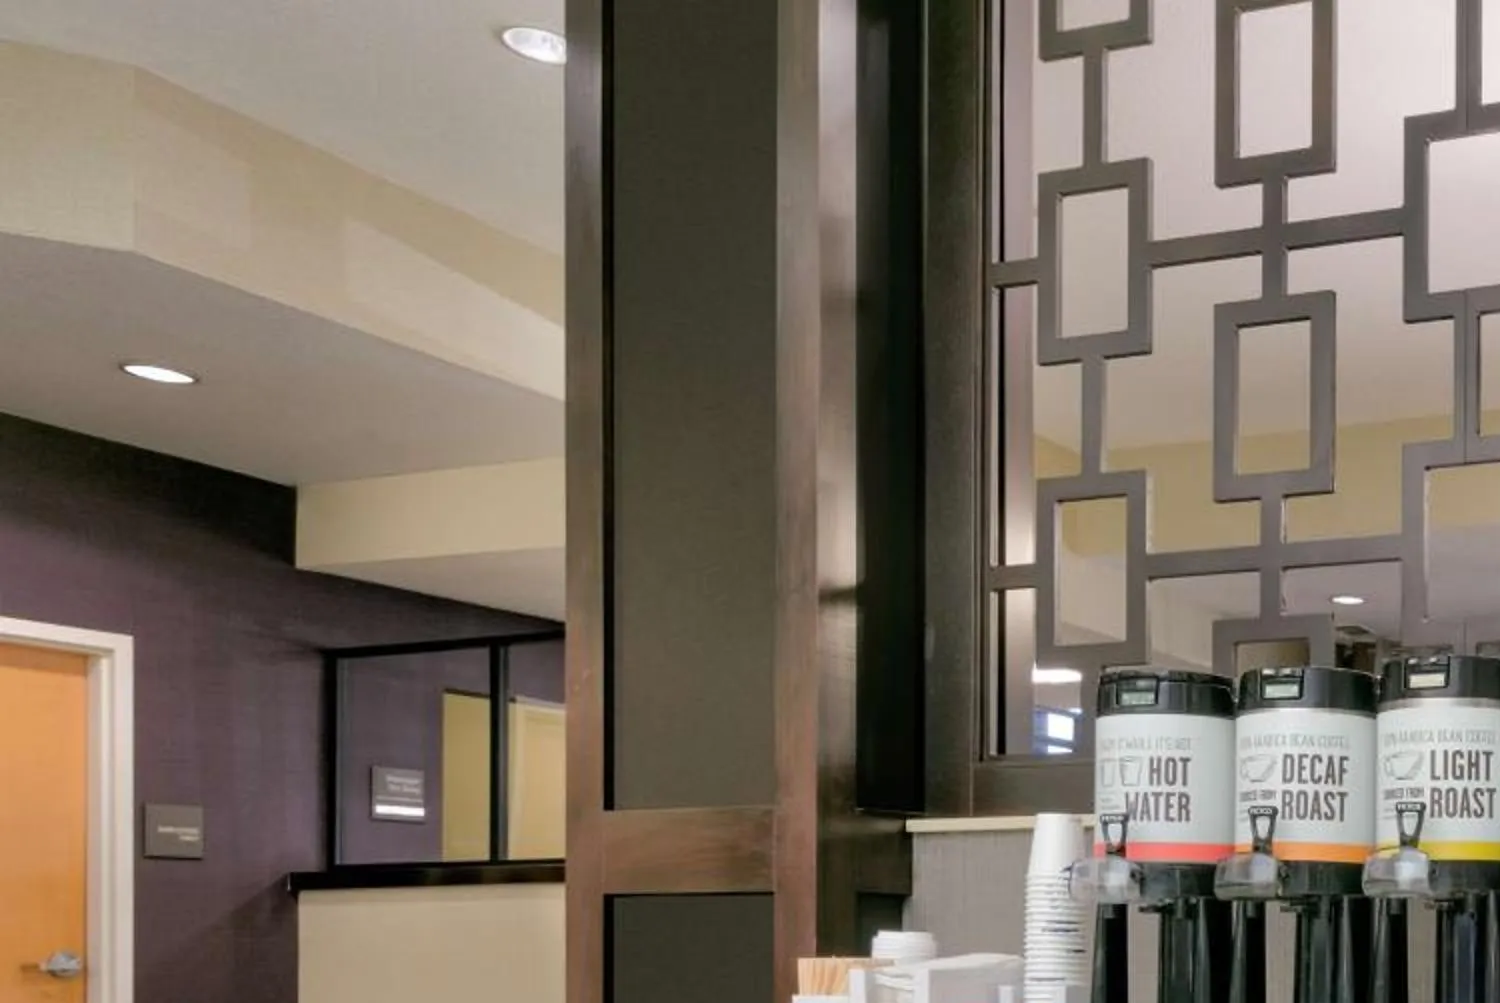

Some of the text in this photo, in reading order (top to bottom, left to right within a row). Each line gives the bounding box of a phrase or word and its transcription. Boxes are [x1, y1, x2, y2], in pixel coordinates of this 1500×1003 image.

[1149, 756, 1192, 787] HOT
[1281, 753, 1350, 786] DECAF
[1430, 749, 1494, 781] LIGHT
[1125, 791, 1191, 822] WATER
[1280, 789, 1349, 822] ROAST
[1429, 787, 1497, 820] ROAST
